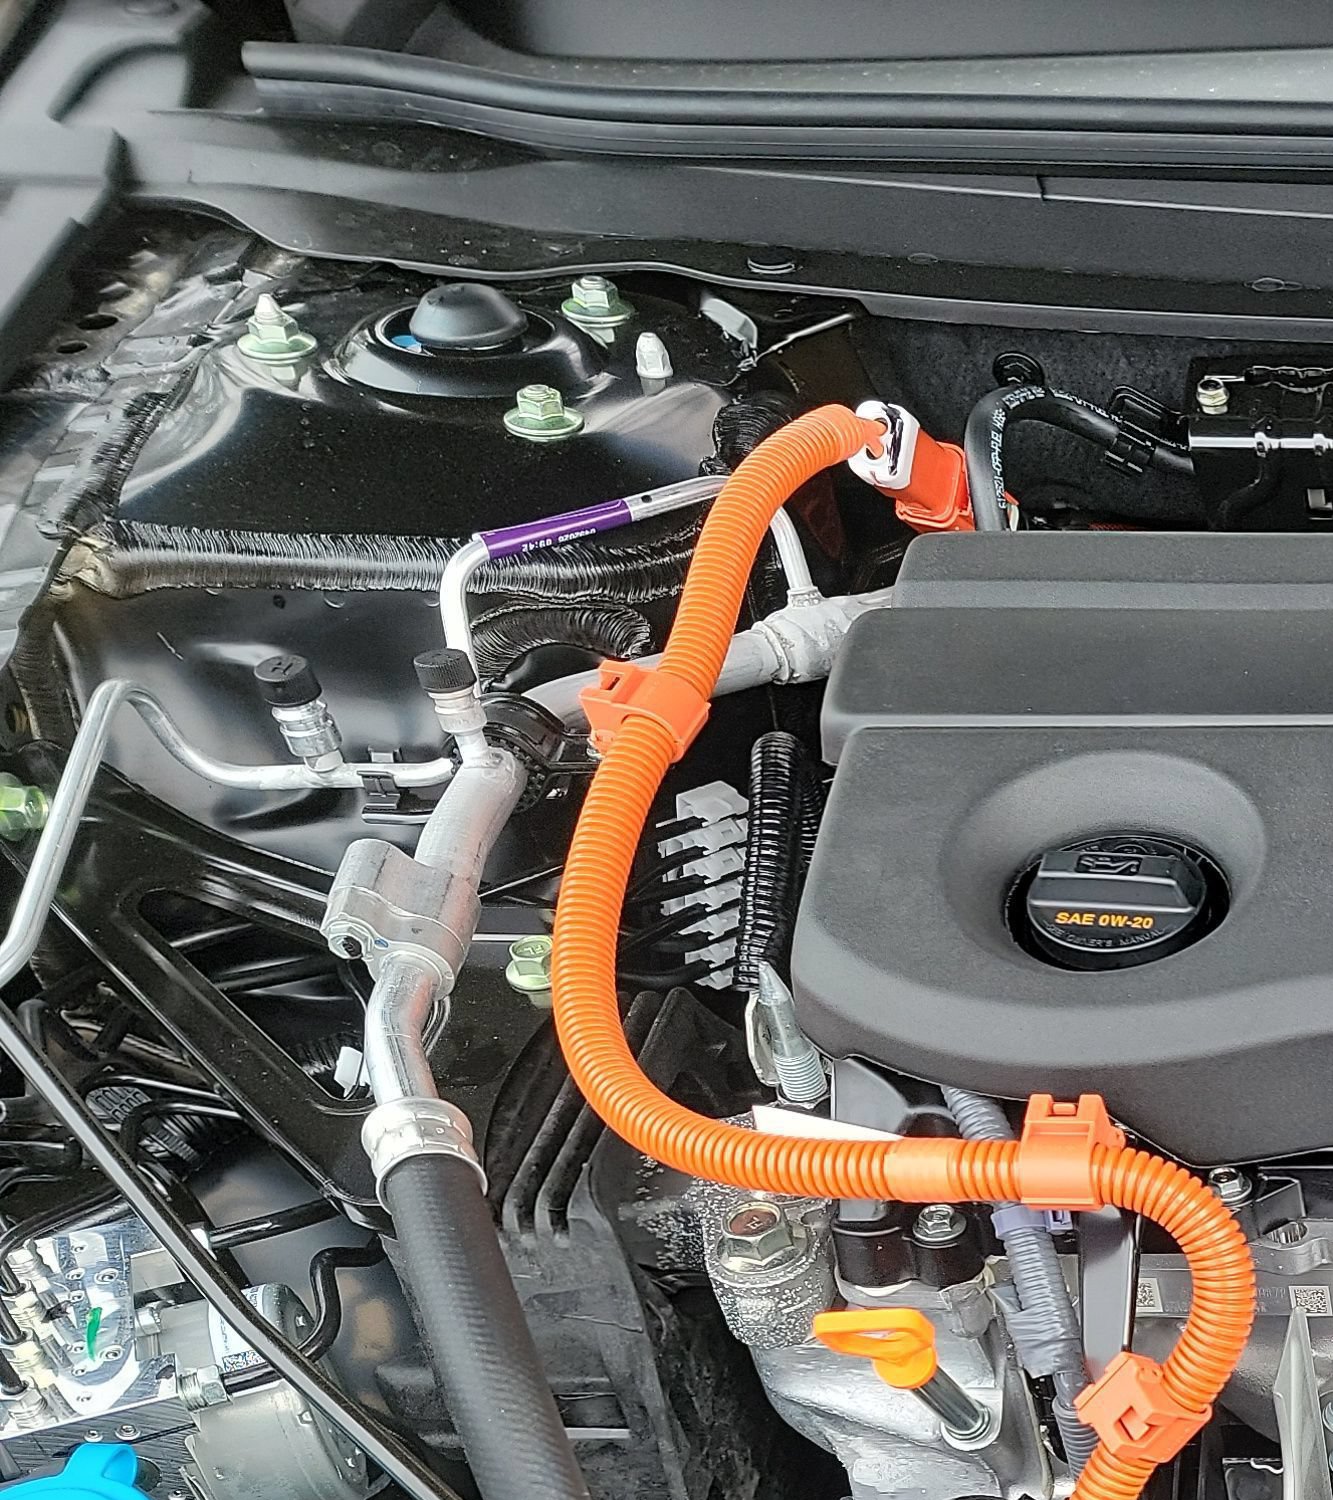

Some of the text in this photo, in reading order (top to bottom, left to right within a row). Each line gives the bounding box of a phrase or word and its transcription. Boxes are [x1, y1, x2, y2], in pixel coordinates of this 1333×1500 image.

[1055, 911, 1153, 929] SAE 0W-20
[1066, 932, 1113, 947] OWNER'S
[1119, 929, 1166, 946] MANUAL
